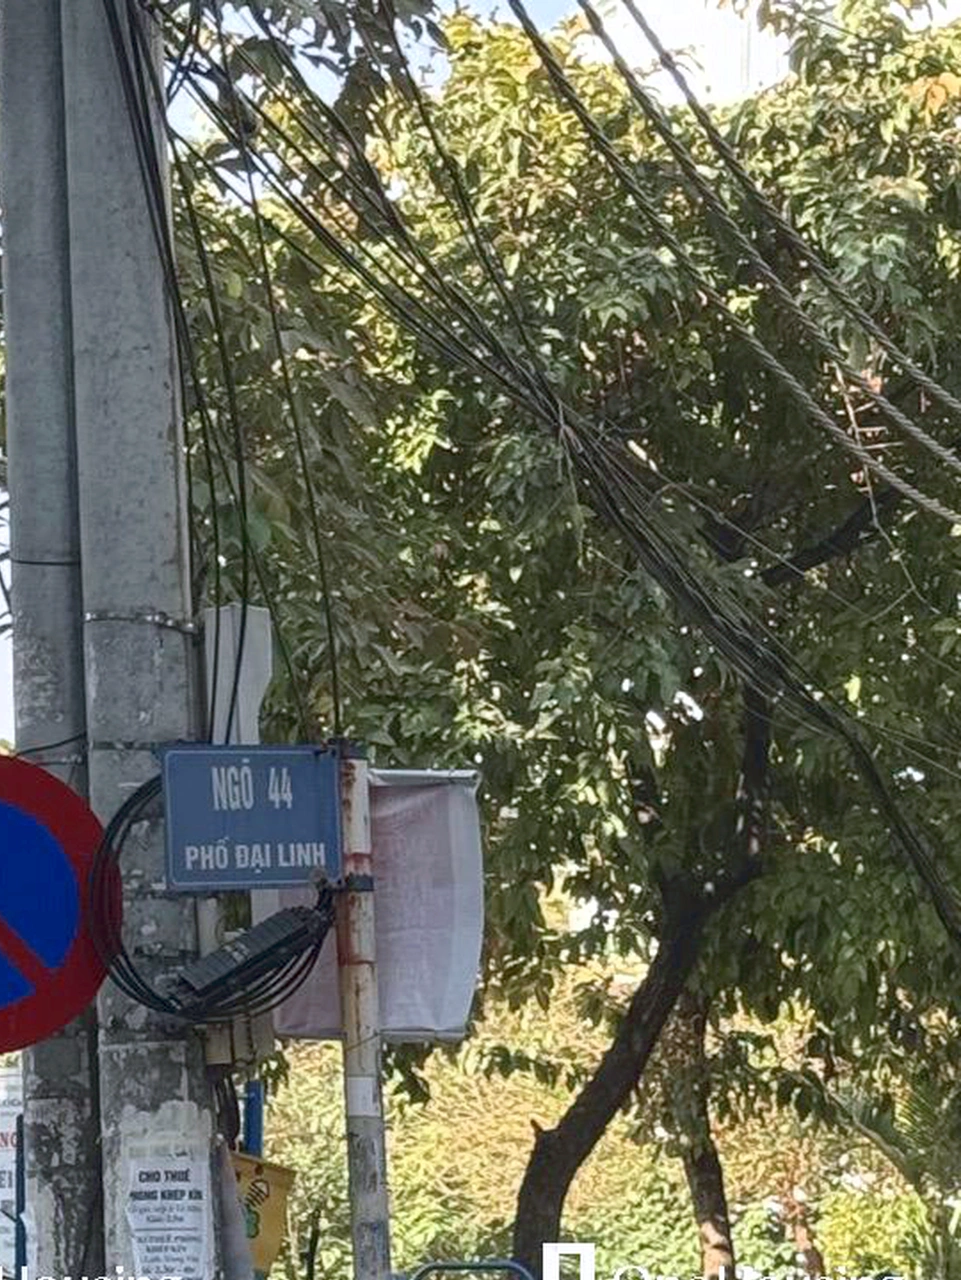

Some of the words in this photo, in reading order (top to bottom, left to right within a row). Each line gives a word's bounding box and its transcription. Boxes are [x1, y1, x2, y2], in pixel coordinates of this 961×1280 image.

[211, 758, 254, 811] NGÕ
[268, 767, 293, 810] 44
[185, 836, 230, 870] PHỐ
[235, 844, 271, 874] ĐẠI
[278, 843, 326, 867] LINH
